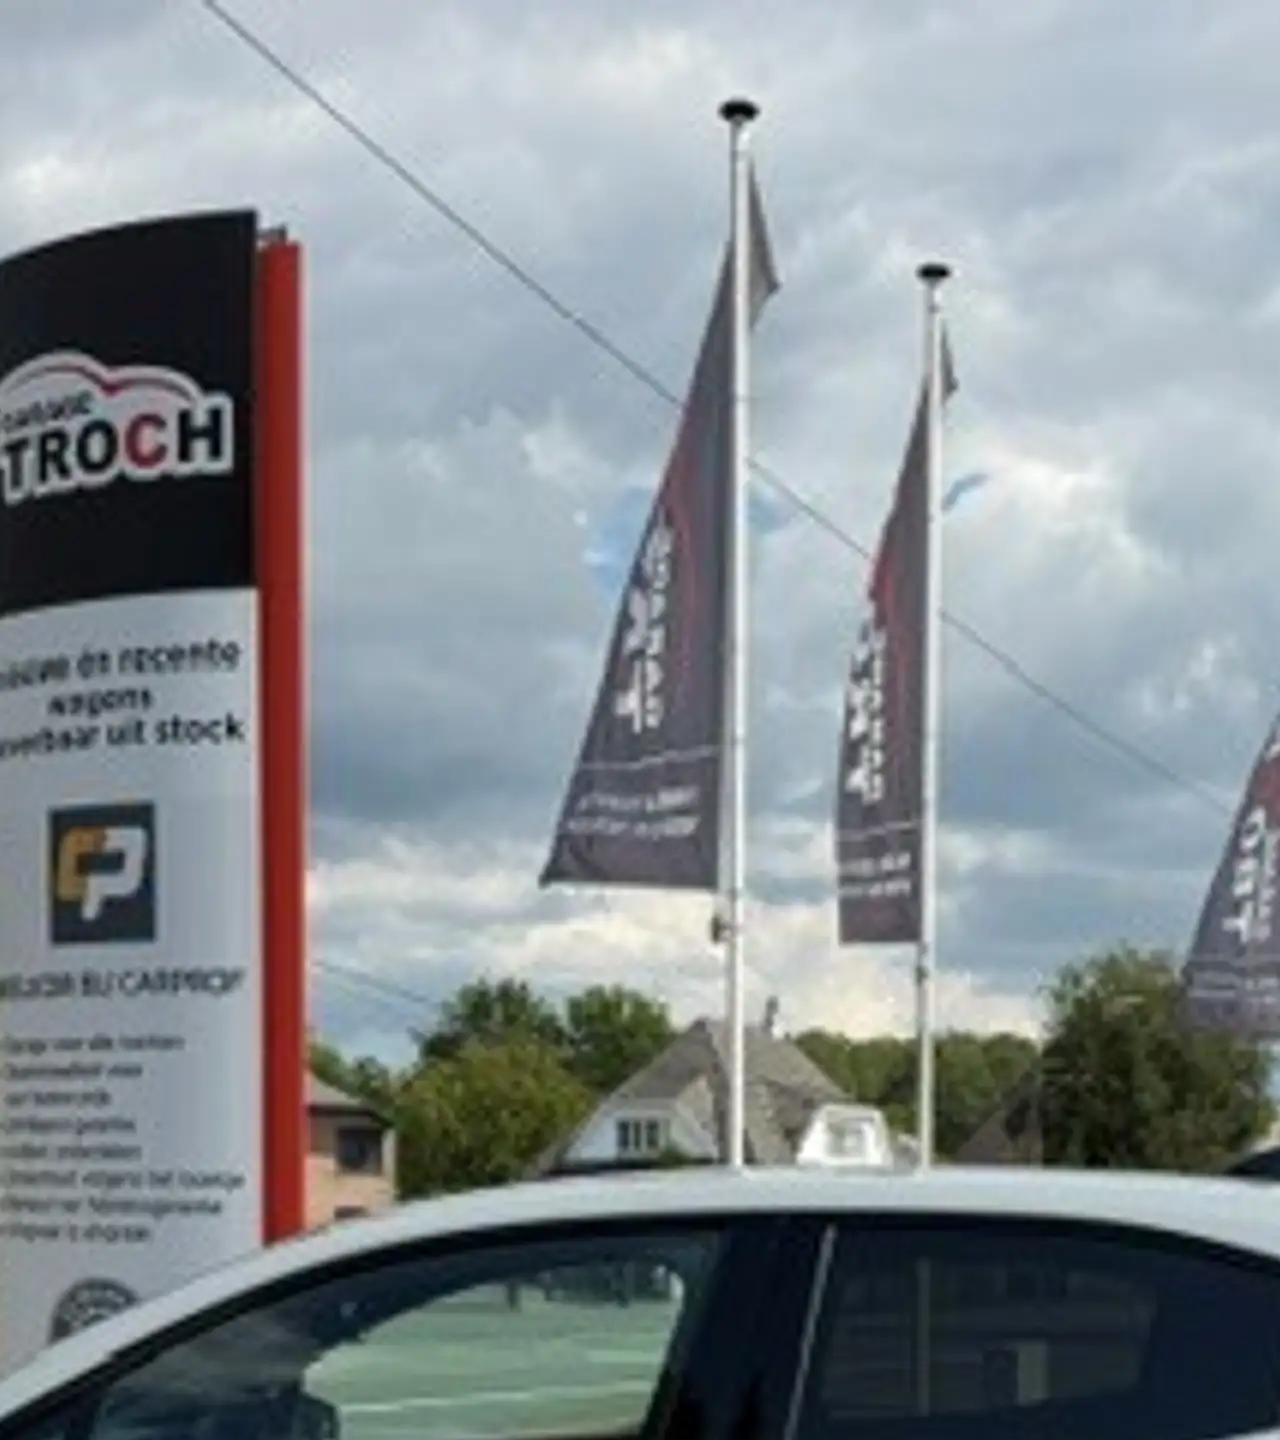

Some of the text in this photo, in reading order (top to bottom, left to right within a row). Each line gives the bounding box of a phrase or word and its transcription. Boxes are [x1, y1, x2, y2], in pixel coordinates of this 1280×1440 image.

[3, 408, 223, 490] TROCH
[105, 719, 147, 747] uit
[155, 711, 246, 746] stock
